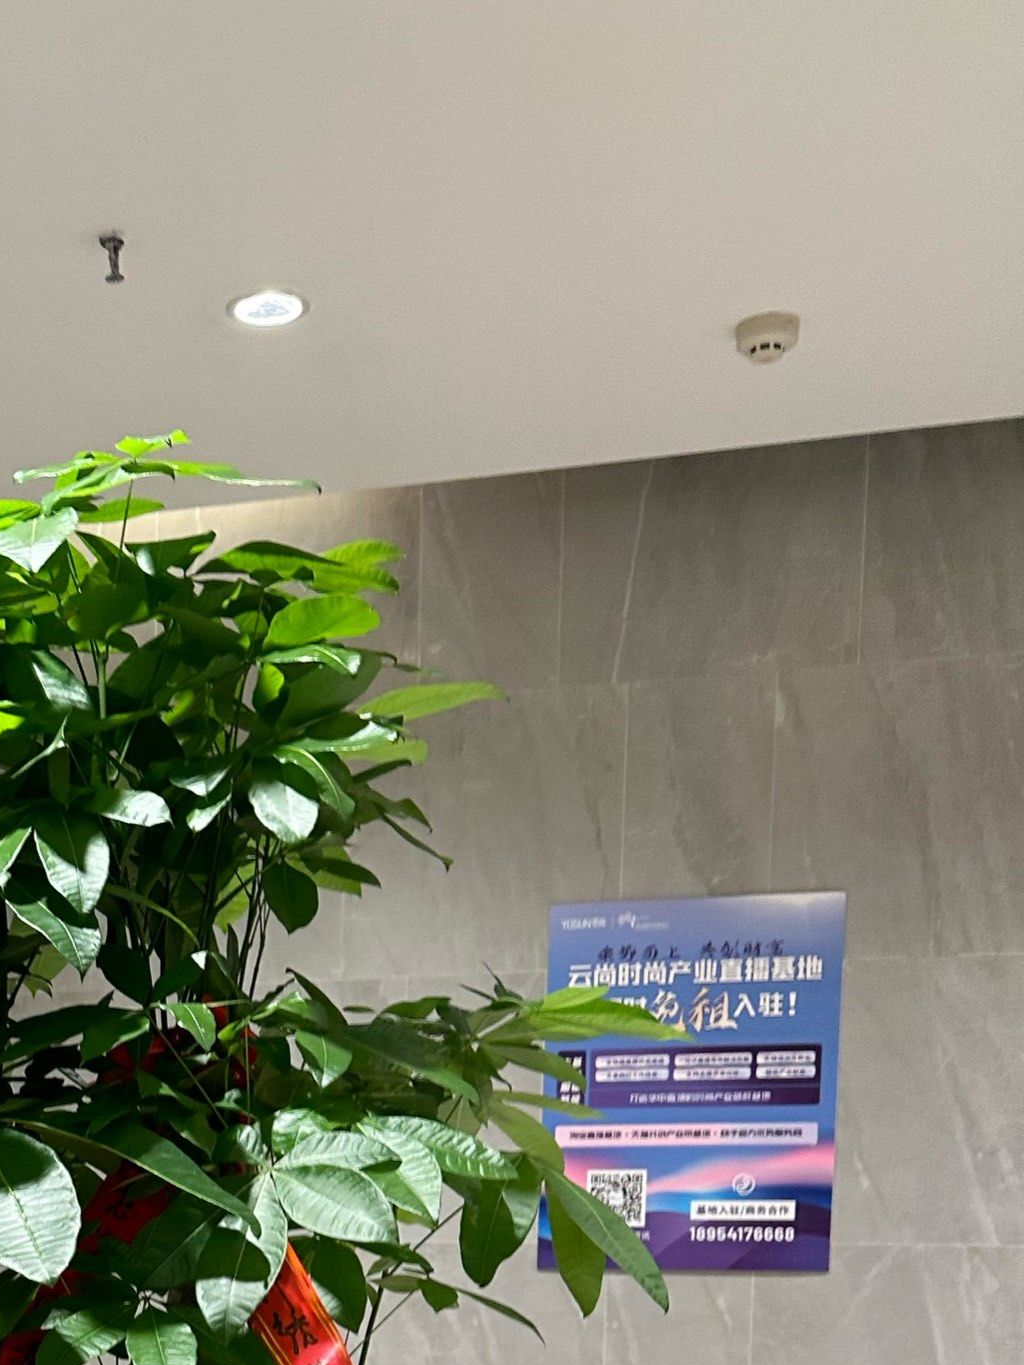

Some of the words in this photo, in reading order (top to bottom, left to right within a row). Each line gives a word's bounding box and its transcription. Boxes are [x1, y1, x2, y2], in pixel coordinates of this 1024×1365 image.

[568, 954, 823, 989] 云尚时尚产业直播基地
